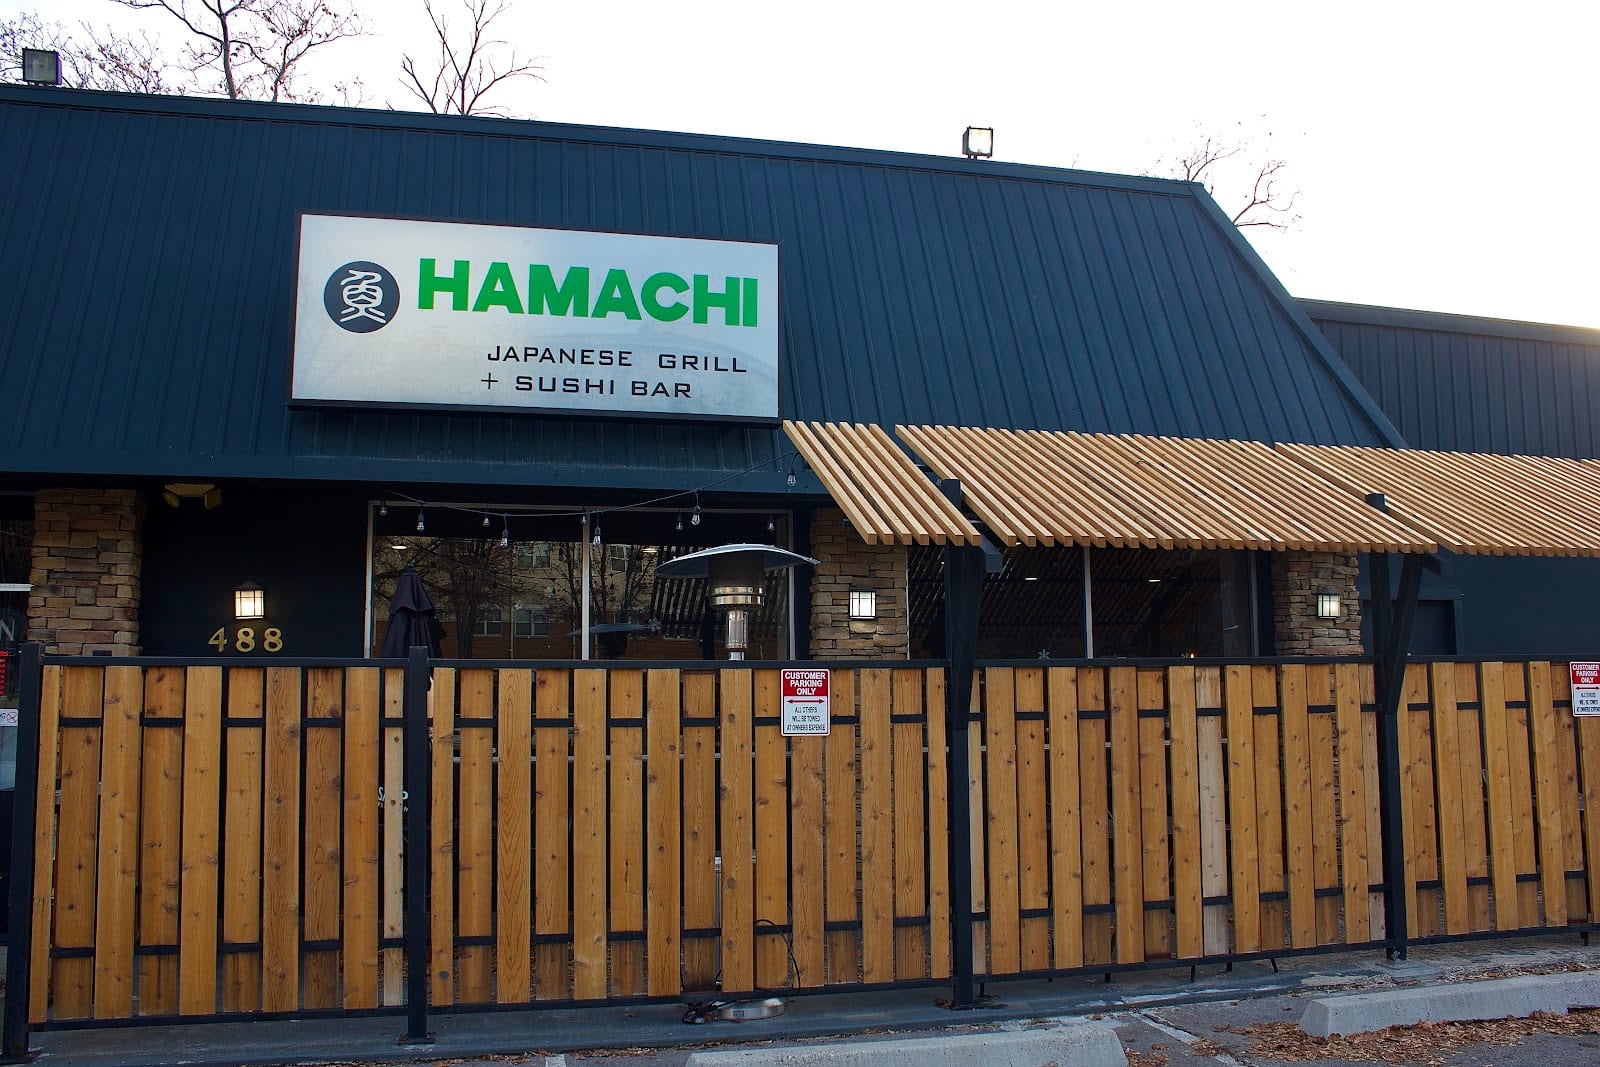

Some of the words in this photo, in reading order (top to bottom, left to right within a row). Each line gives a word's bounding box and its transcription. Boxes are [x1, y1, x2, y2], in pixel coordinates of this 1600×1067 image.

[418, 258, 758, 328] HAMACHI
[487, 345, 633, 367] JAPANESE
[658, 354, 748, 373] GRILL
[515, 375, 615, 395] SUSHI
[631, 381, 692, 399] BAR
[208, 627, 283, 652] 488
